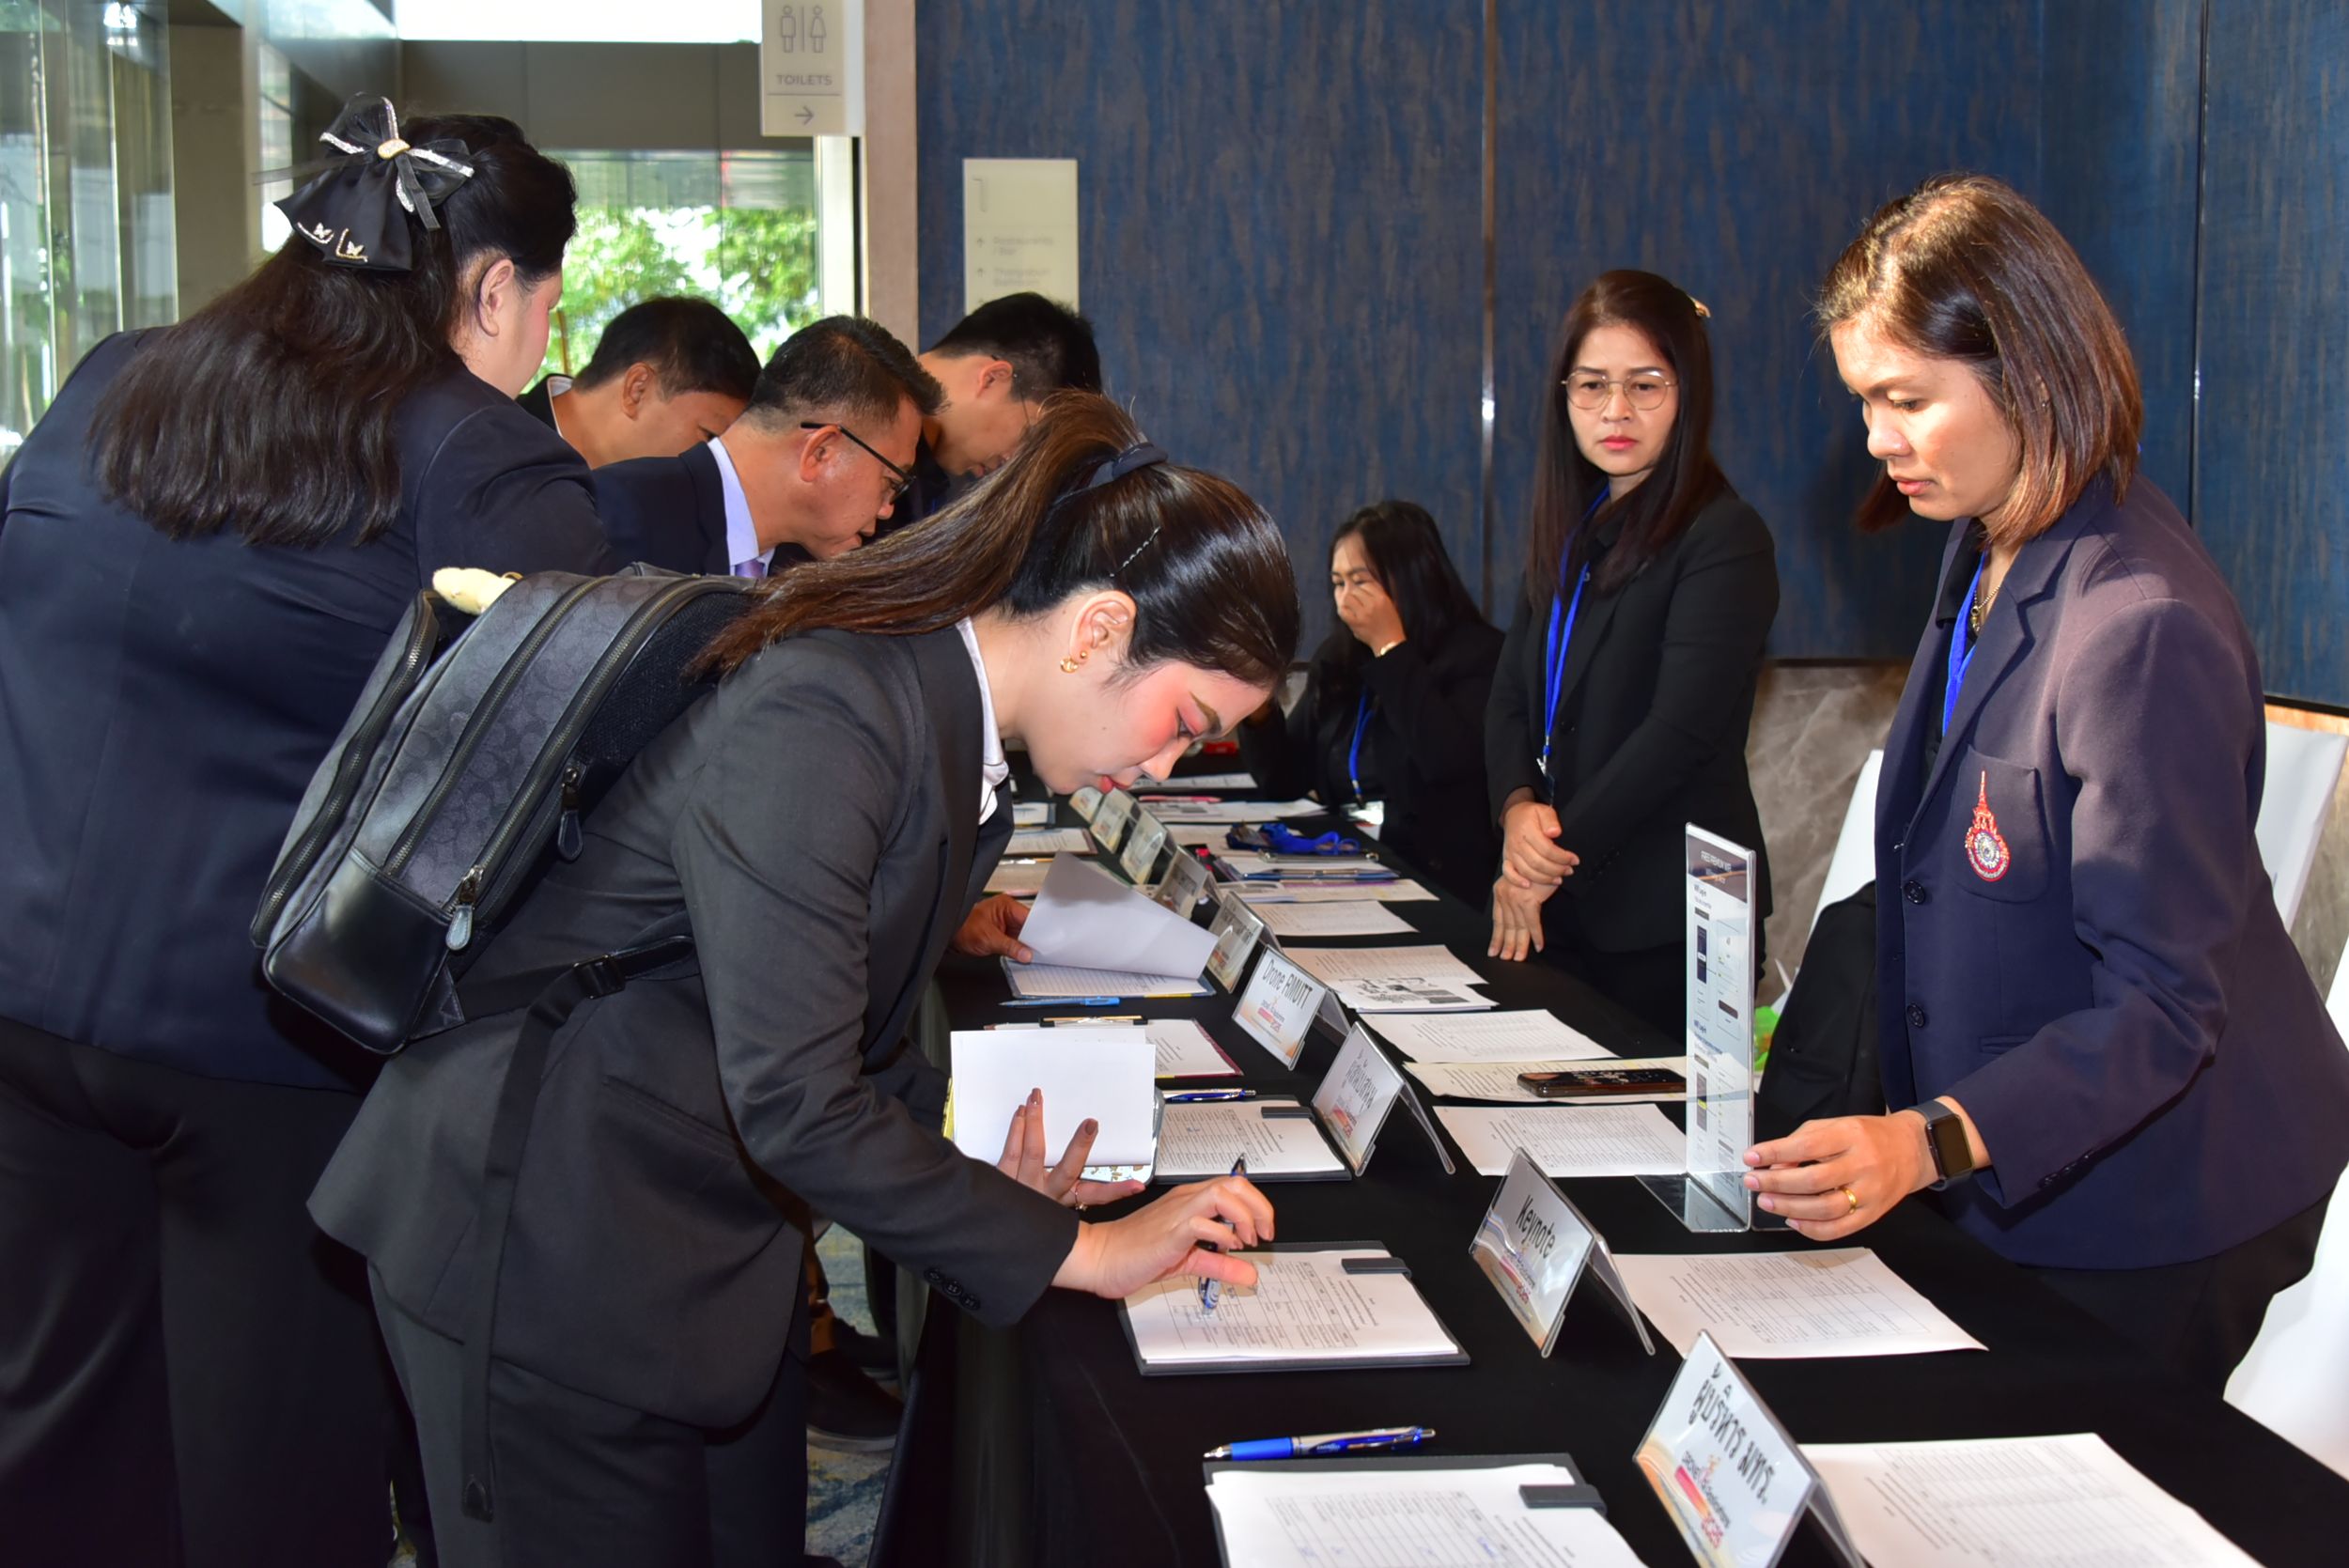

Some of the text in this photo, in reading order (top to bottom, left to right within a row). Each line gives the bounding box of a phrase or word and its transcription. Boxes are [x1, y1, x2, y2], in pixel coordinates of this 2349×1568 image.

[775, 74, 832, 86] TOILETS
[1262, 958, 1286, 992] Drone
[1281, 972, 1313, 1010] RMUTT
[1516, 1194, 1556, 1259] Keynote
[1688, 1362, 1747, 1460] ผู้บริหาร
[1737, 1440, 1775, 1504] มทร.
